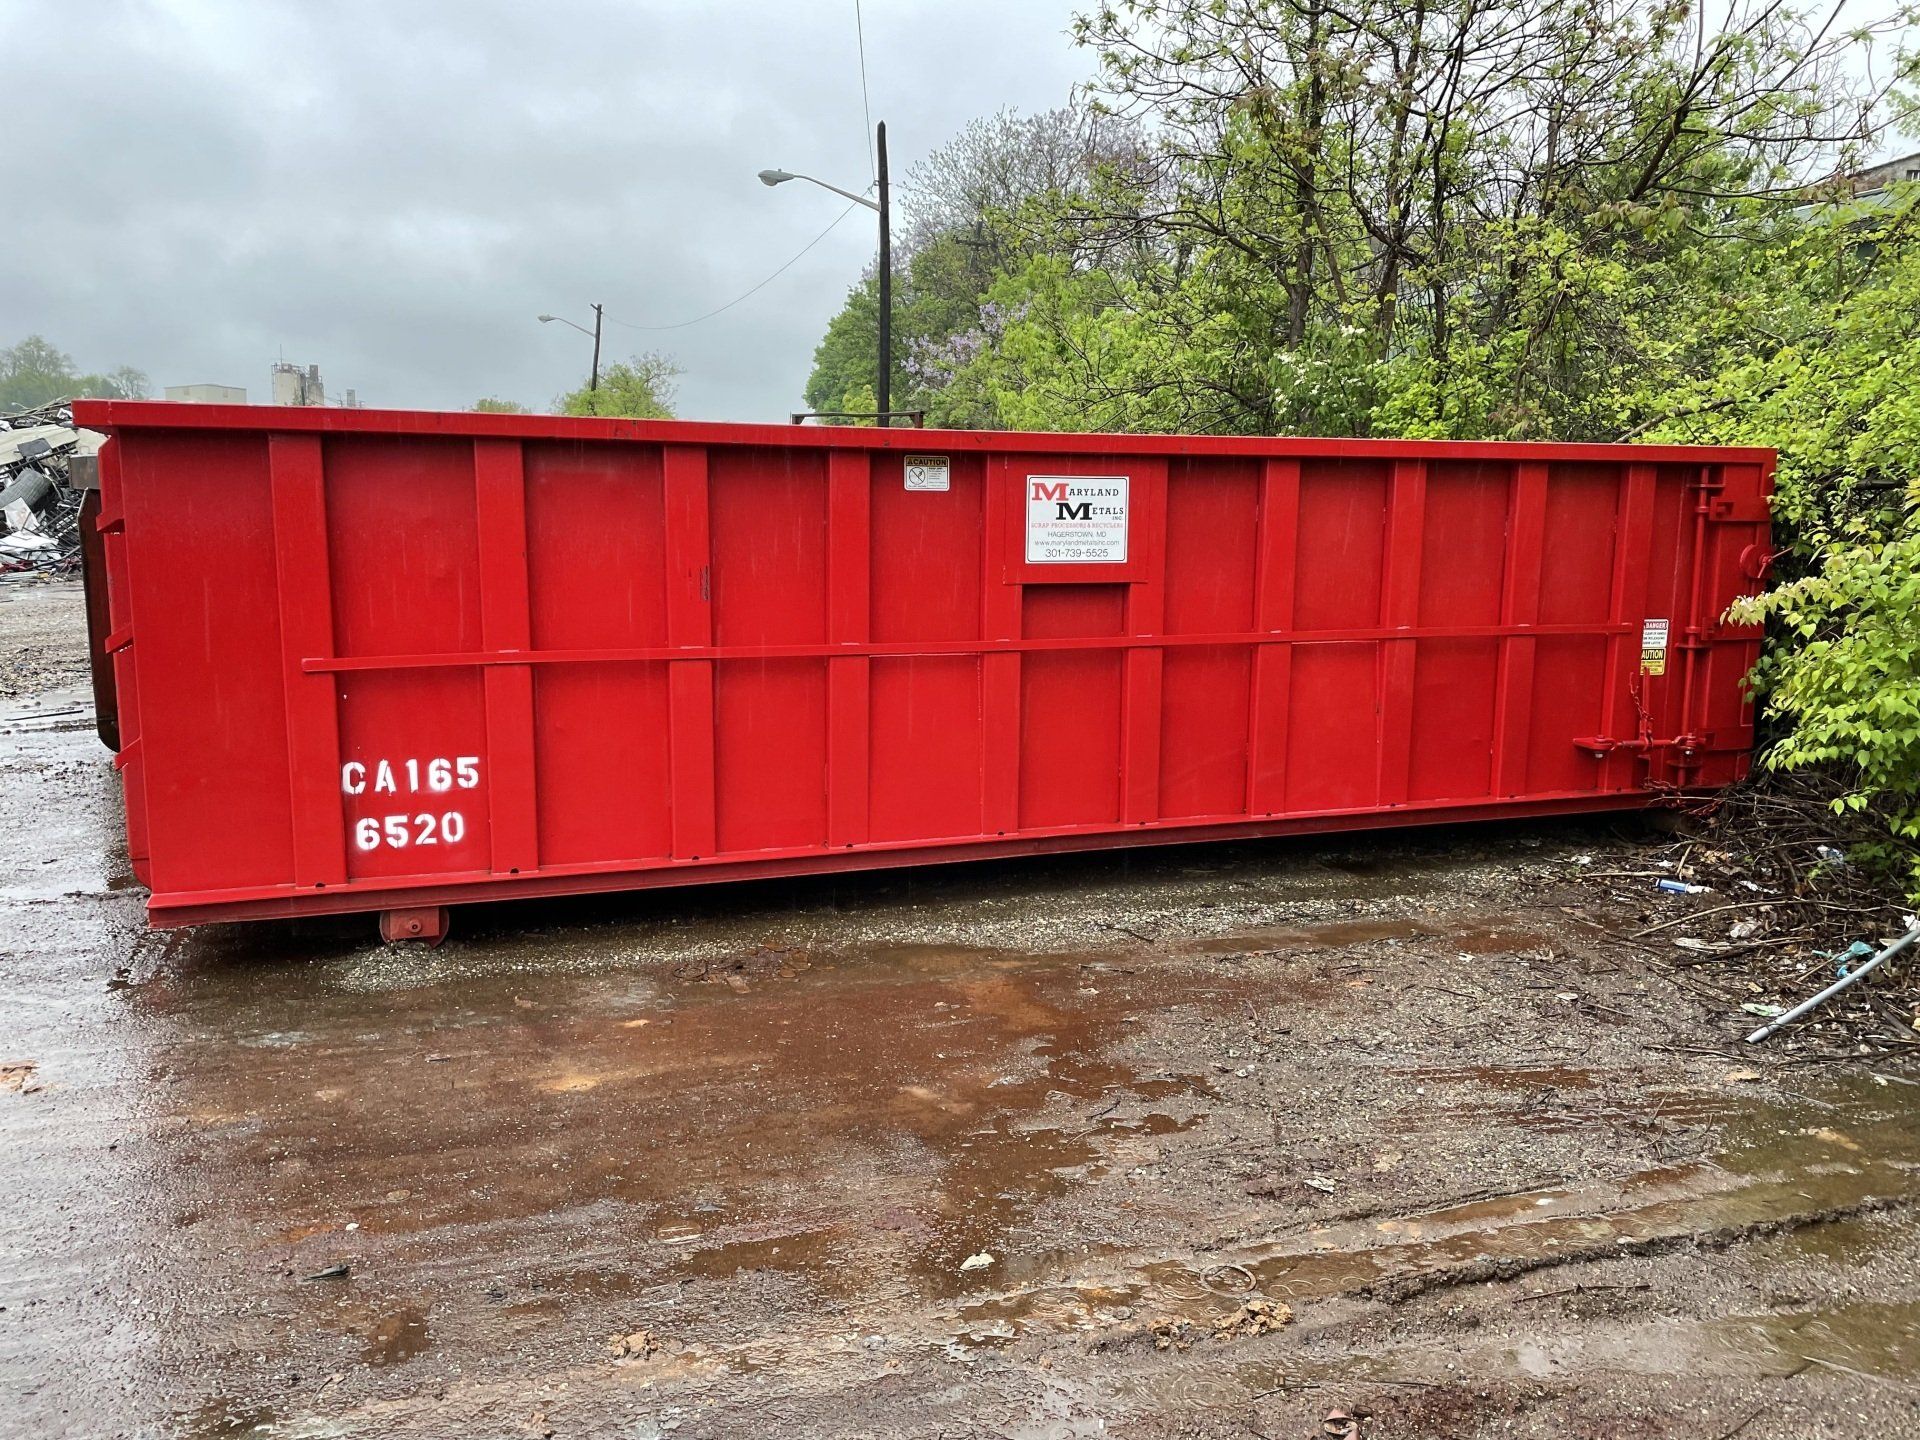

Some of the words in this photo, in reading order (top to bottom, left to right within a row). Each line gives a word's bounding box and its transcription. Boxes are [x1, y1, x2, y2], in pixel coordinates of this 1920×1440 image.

[1032, 482, 1119, 501] MARYLAND
[1056, 502, 1124, 520] METALS
[1045, 548, 1108, 558] 301-739-5525
[1641, 649, 1663, 659] AUTION
[342, 756, 479, 795] CA165
[356, 811, 464, 850] 6520
